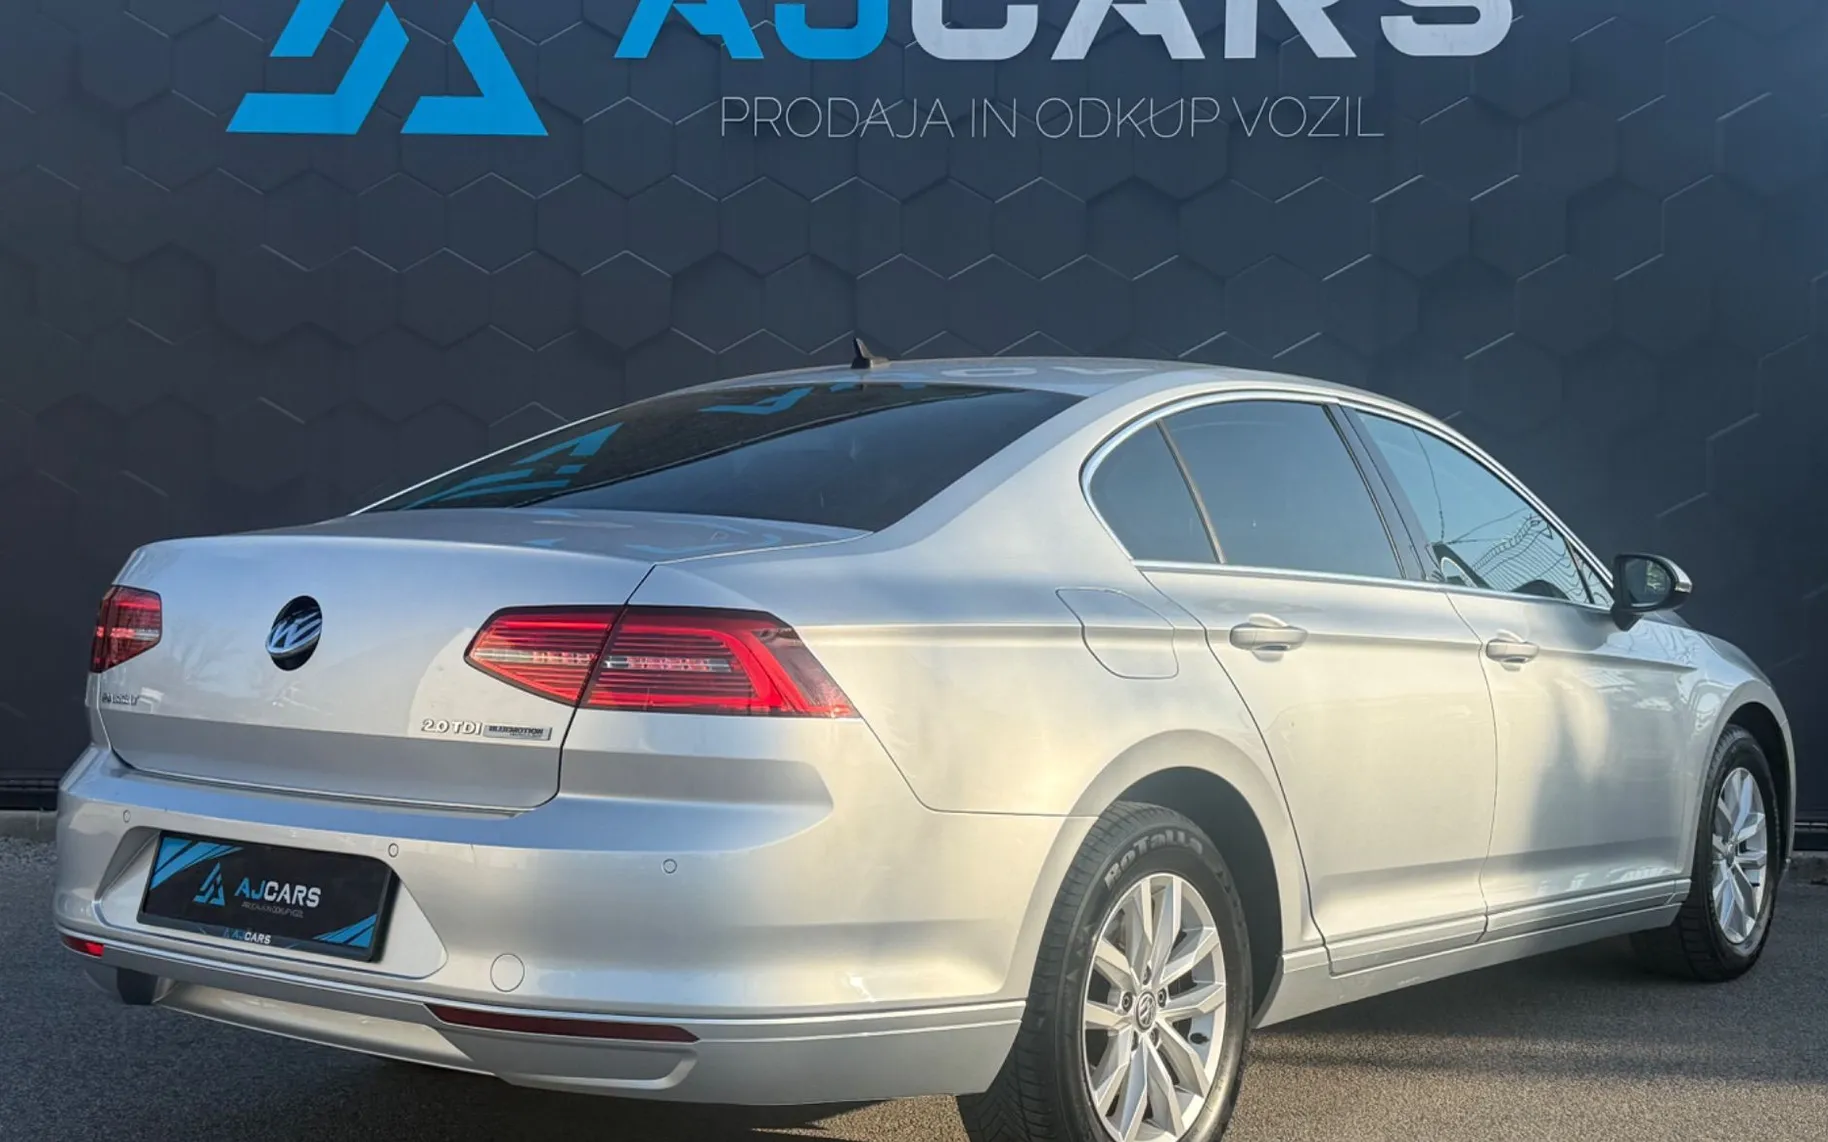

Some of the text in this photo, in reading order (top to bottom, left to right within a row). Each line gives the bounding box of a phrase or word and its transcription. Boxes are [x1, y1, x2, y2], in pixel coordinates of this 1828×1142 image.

[720, 95, 1385, 138] PRODAJA IN ODKUP VOZIL
[421, 718, 449, 733] 2.0
[451, 720, 482, 736] TDI
[234, 877, 322, 908] AJCARS
